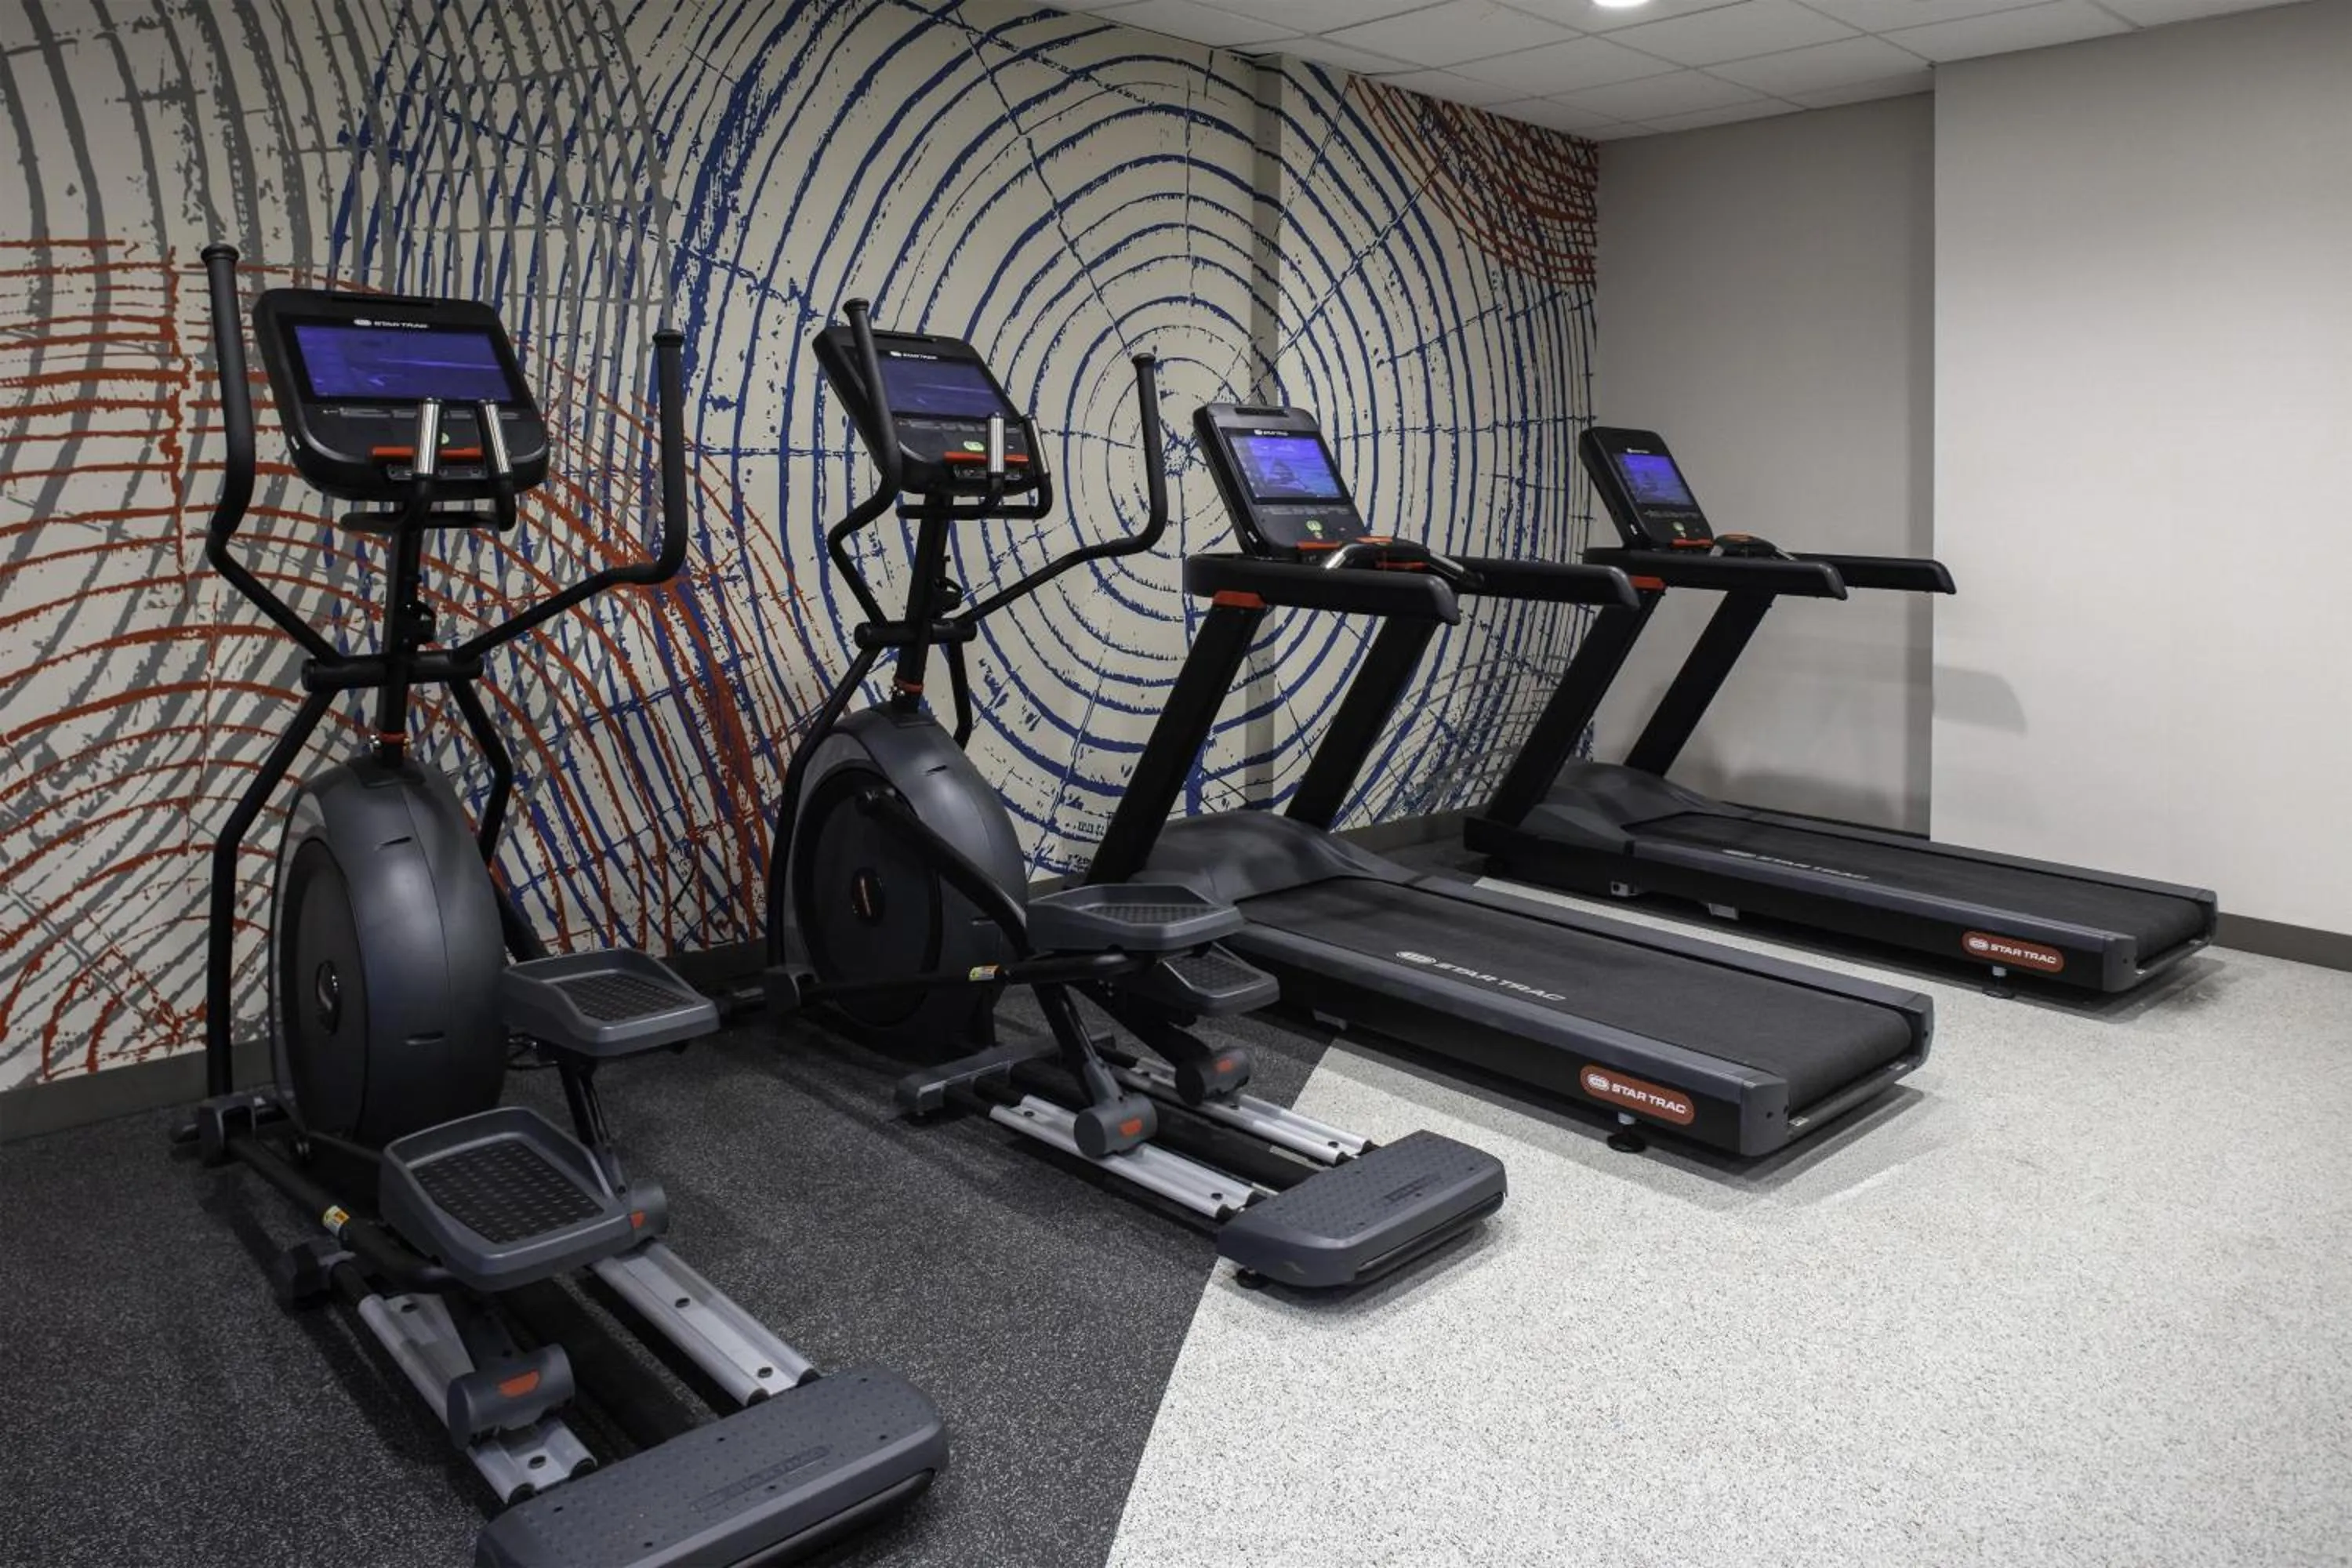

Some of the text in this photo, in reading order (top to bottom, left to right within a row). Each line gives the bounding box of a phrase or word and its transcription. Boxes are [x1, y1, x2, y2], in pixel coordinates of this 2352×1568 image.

[1990, 943, 2057, 964] STAR TRAC
[1433, 962, 1567, 1001] STAR TRAC
[1611, 1083, 1687, 1115] STAR TRAC
